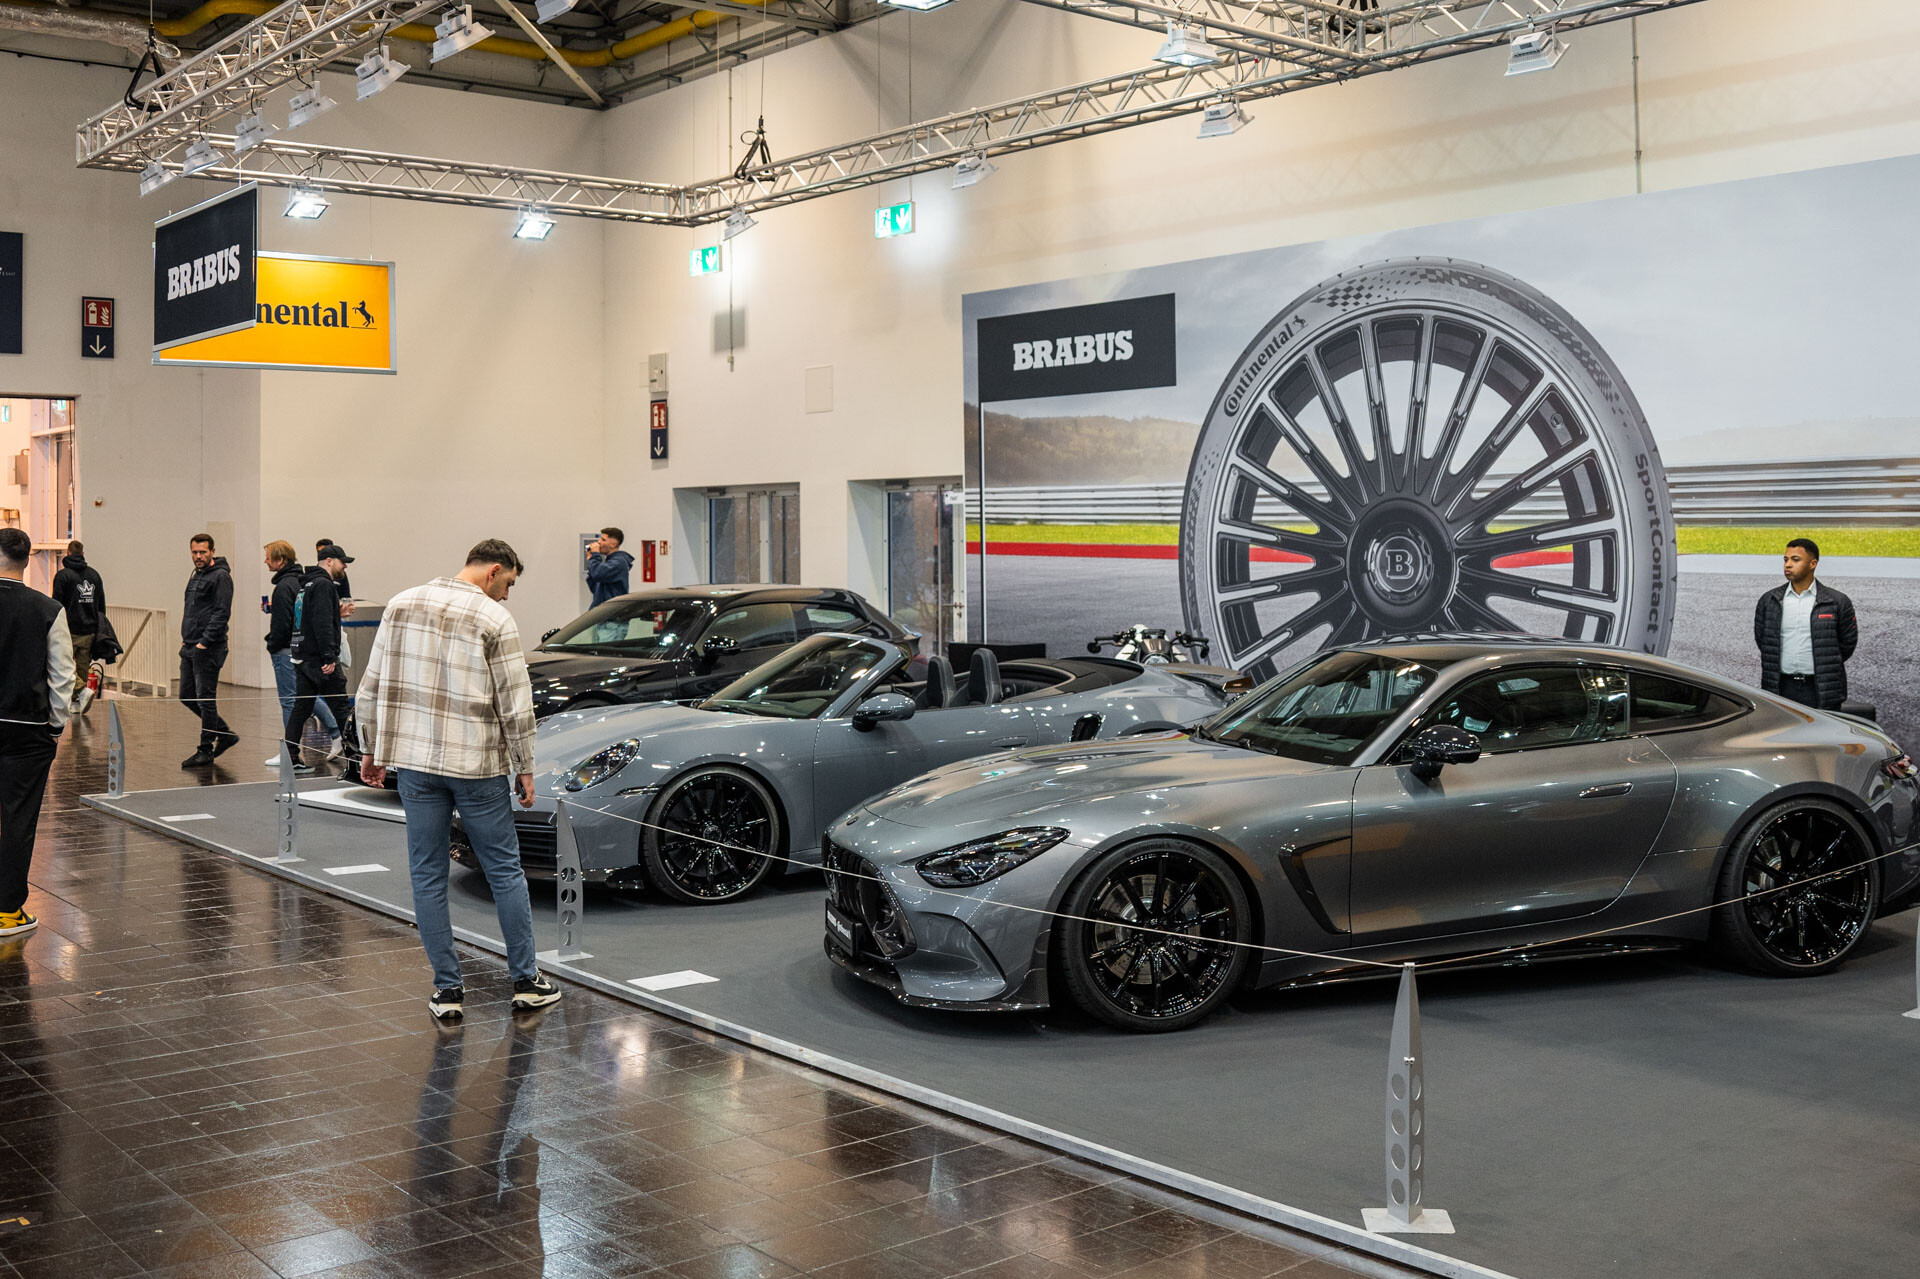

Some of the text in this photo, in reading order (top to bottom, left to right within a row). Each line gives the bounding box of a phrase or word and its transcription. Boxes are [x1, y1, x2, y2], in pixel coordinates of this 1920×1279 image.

[167, 244, 241, 301] BRABUS
[1013, 330, 1134, 371] BRABUS
[1223, 322, 1295, 418] Continental
[1385, 549, 1414, 579] B
[1635, 453, 1664, 634] SportContact
